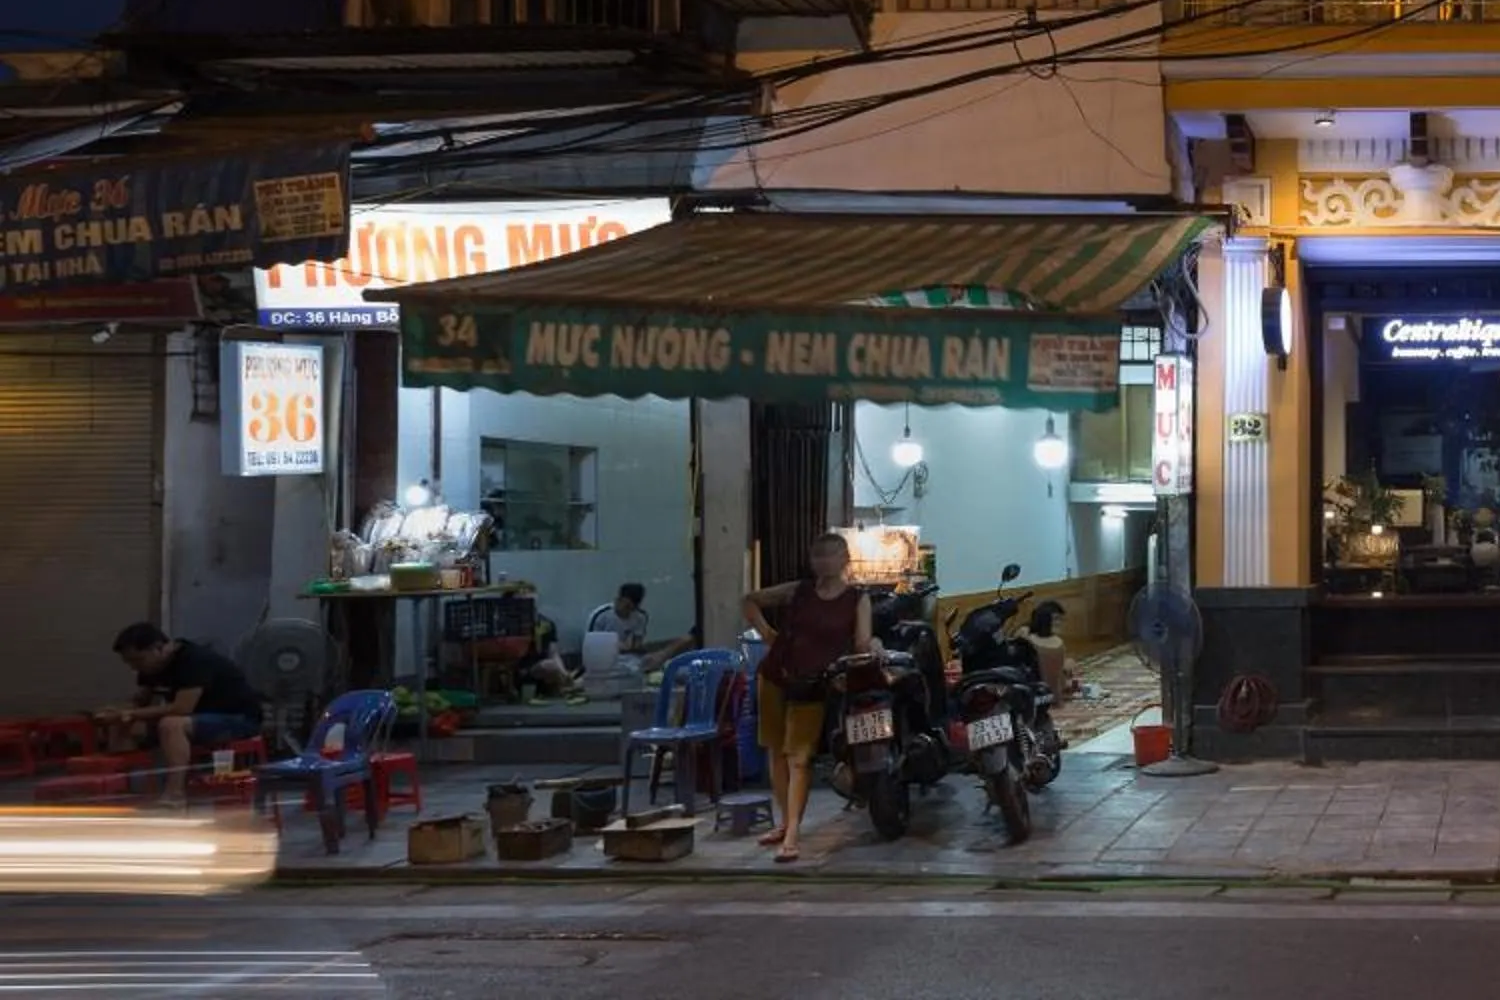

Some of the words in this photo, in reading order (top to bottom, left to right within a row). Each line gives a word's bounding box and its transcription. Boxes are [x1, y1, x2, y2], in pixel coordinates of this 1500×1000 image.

[54, 216, 152, 250] CHUA
[162, 202, 243, 239] RÁN
[271, 312, 301, 325] ĐC:
[305, 311, 325, 323] 36
[329, 311, 372, 325] Hàng
[436, 313, 479, 348] 34
[764, 330, 838, 376] NEM
[847, 331, 934, 379] CHUA
[941, 328, 1012, 382] RÁN
[249, 390, 317, 443] 36
